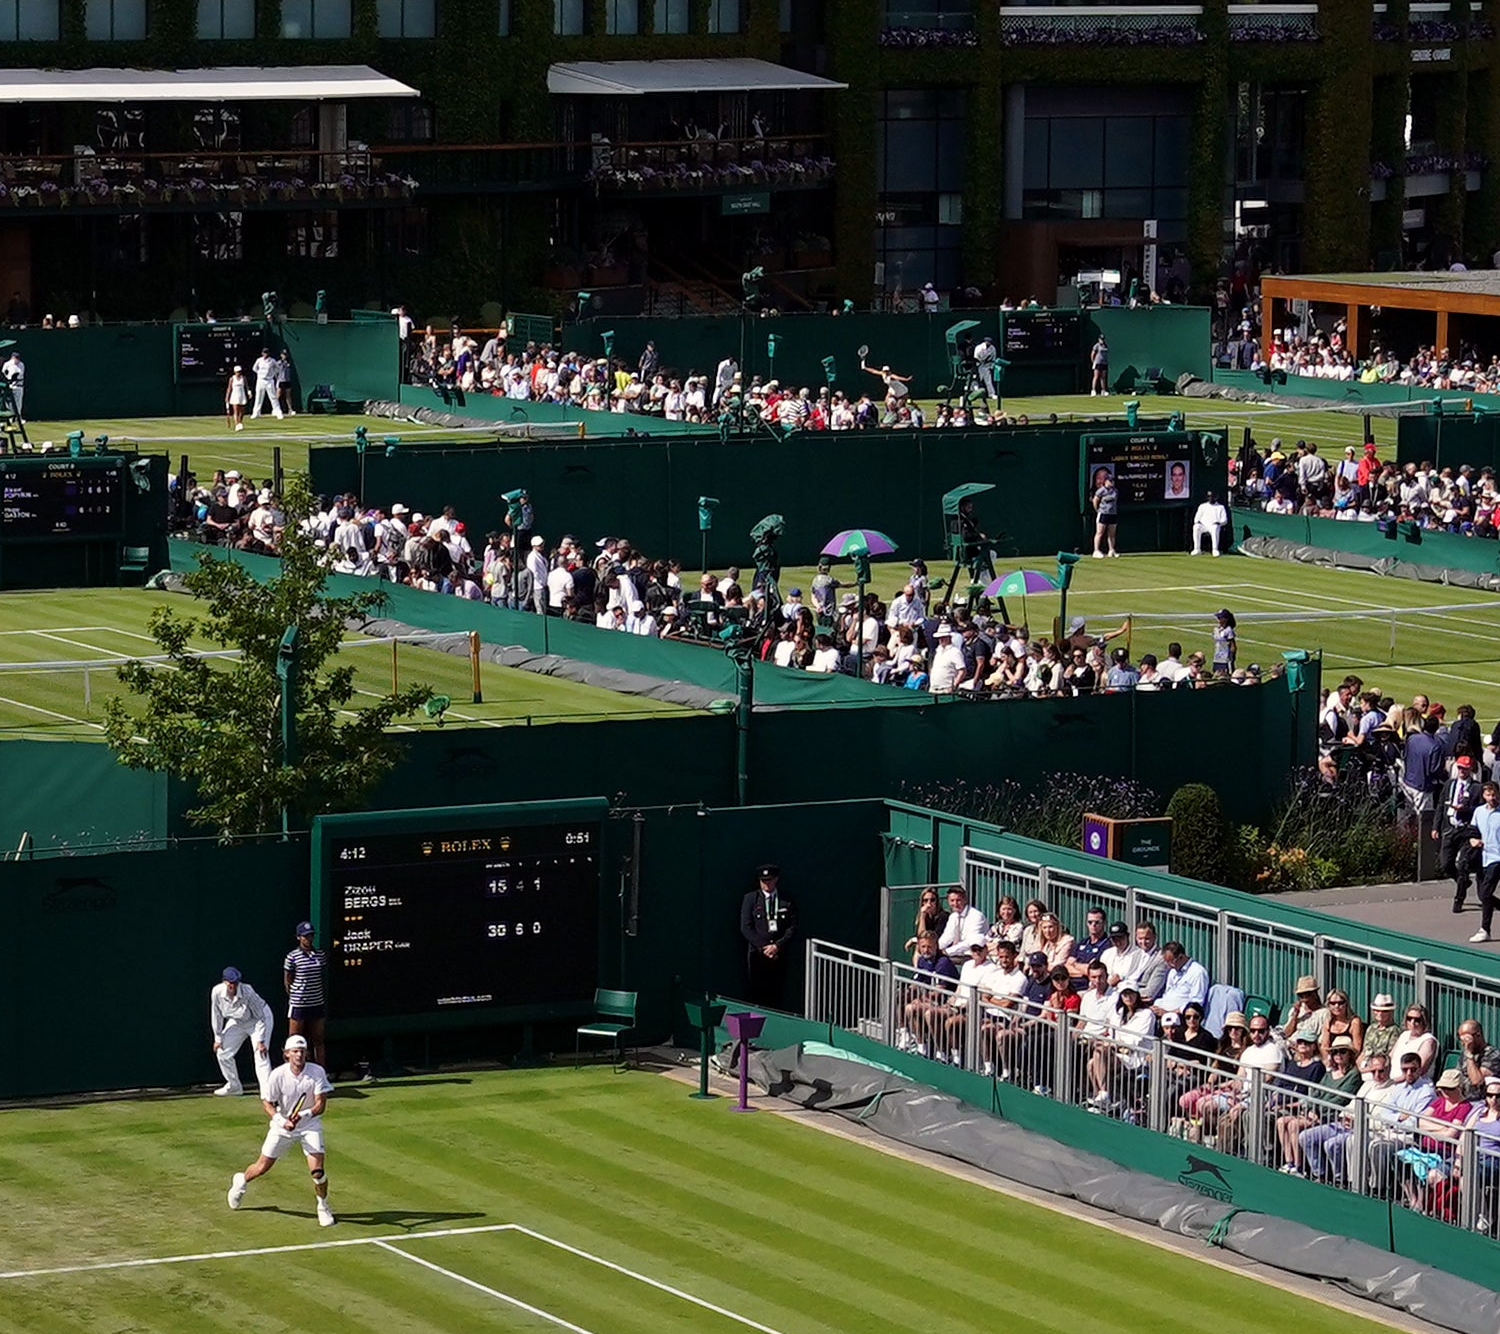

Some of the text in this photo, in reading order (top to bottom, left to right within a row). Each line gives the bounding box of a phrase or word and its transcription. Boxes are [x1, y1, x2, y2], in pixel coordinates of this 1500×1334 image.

[339, 831, 590, 860] 4:12 ROLEX 0:51
[344, 876, 541, 896] Zizou 15 4 1
[344, 895, 387, 909] BERGS
[343, 921, 541, 941] Jack 30 6 0
[343, 940, 394, 953] DRAPER
